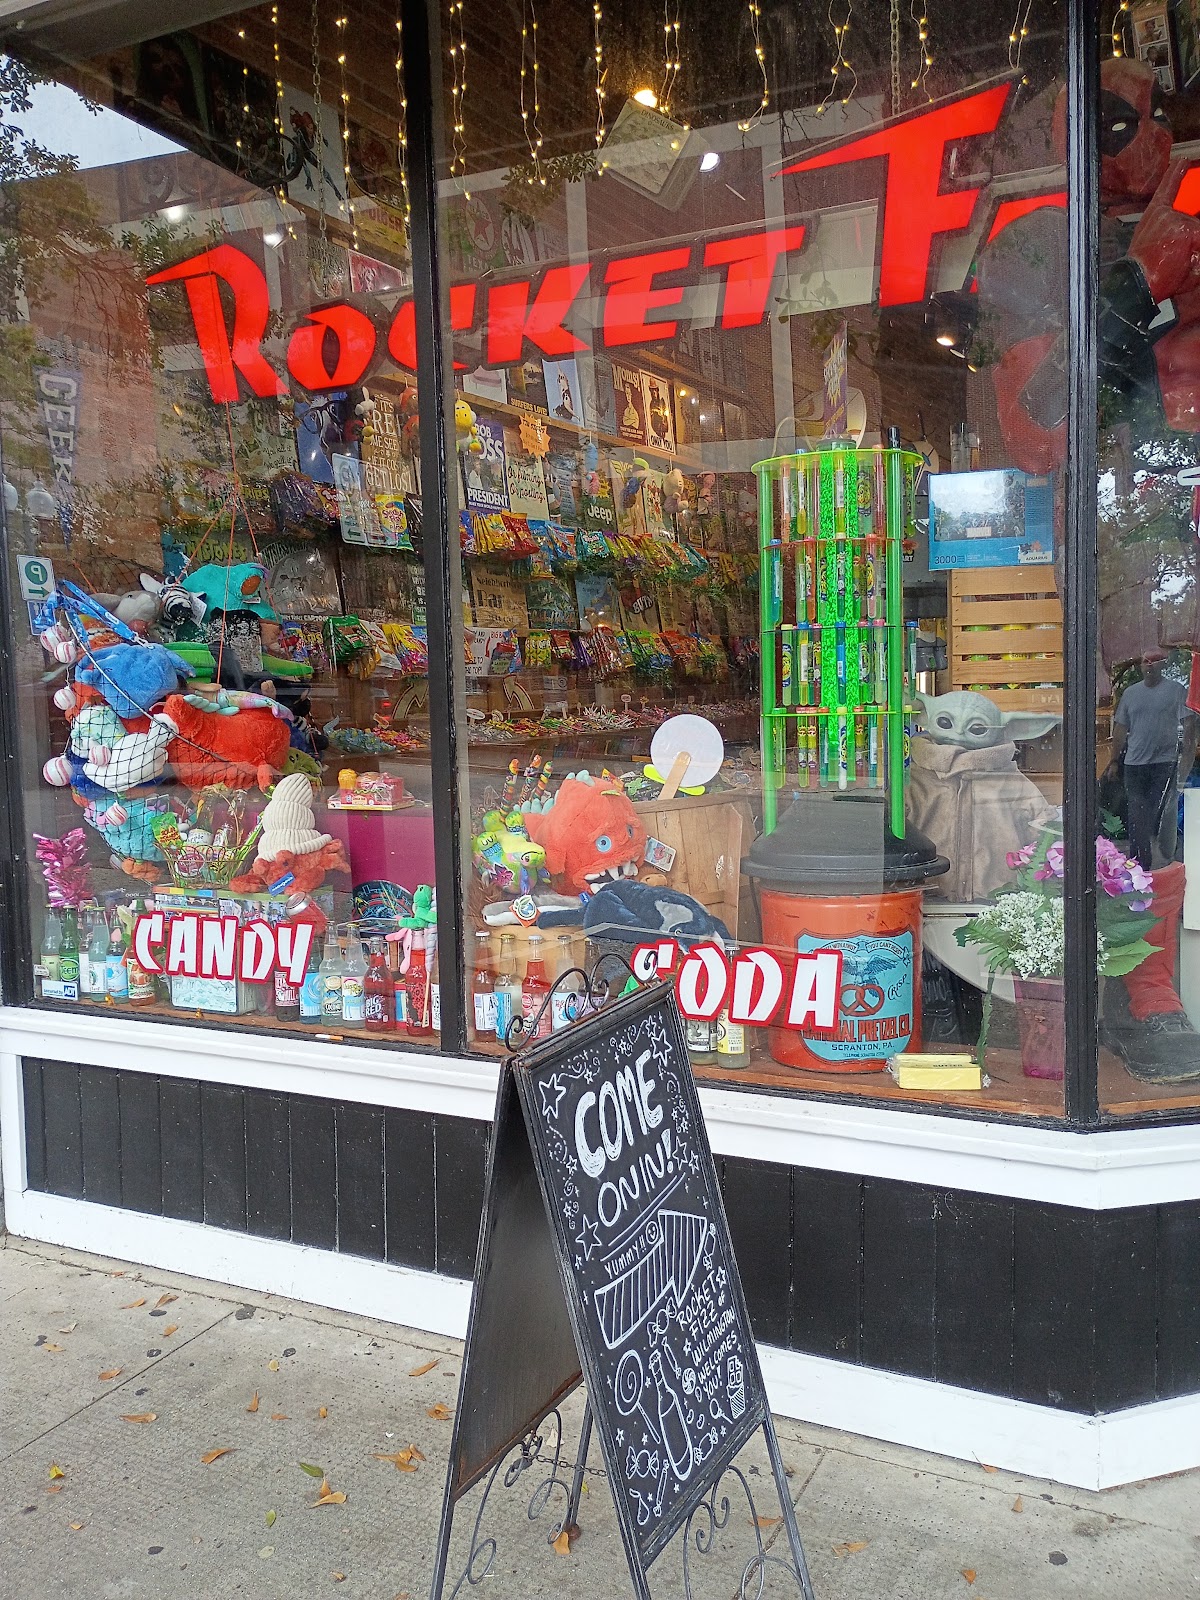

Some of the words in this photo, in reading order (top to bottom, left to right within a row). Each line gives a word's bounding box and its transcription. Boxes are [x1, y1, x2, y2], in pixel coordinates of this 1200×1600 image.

[146, 226, 806, 404] ROCKET
[40, 373, 76, 484] GEEK
[475, 423, 491, 438] BOB
[476, 435, 504, 464] OSS
[366, 463, 387, 489] GET
[389, 472, 412, 492] LOST
[467, 488, 508, 508] PRESIDENT
[587, 503, 613, 525] Jeep
[934, 555, 957, 565] 3000
[134, 911, 315, 985] CANDY
[64, 986, 76, 997] ADT
[365, 995, 380, 1008] BIG
[887, 973, 908, 1001] CRISP
[365, 1004, 382, 1017] RED
[858, 1016, 898, 1043] PRETZEL
[831, 1043, 881, 1052] SCRANTON,
[882, 1042, 895, 1050] PA.
[574, 1050, 664, 1178] COME
[598, 1165, 640, 1227] ON
[638, 1128, 674, 1192] IN!
[675, 1270, 717, 1332] ROCKET
[689, 1300, 718, 1341] FIZZ
[718, 1290, 726, 1306] OF
[691, 1305, 736, 1367] WILMINGTON
[697, 1330, 738, 1385] WELCOMES
[702, 1365, 723, 1400] YOU!
